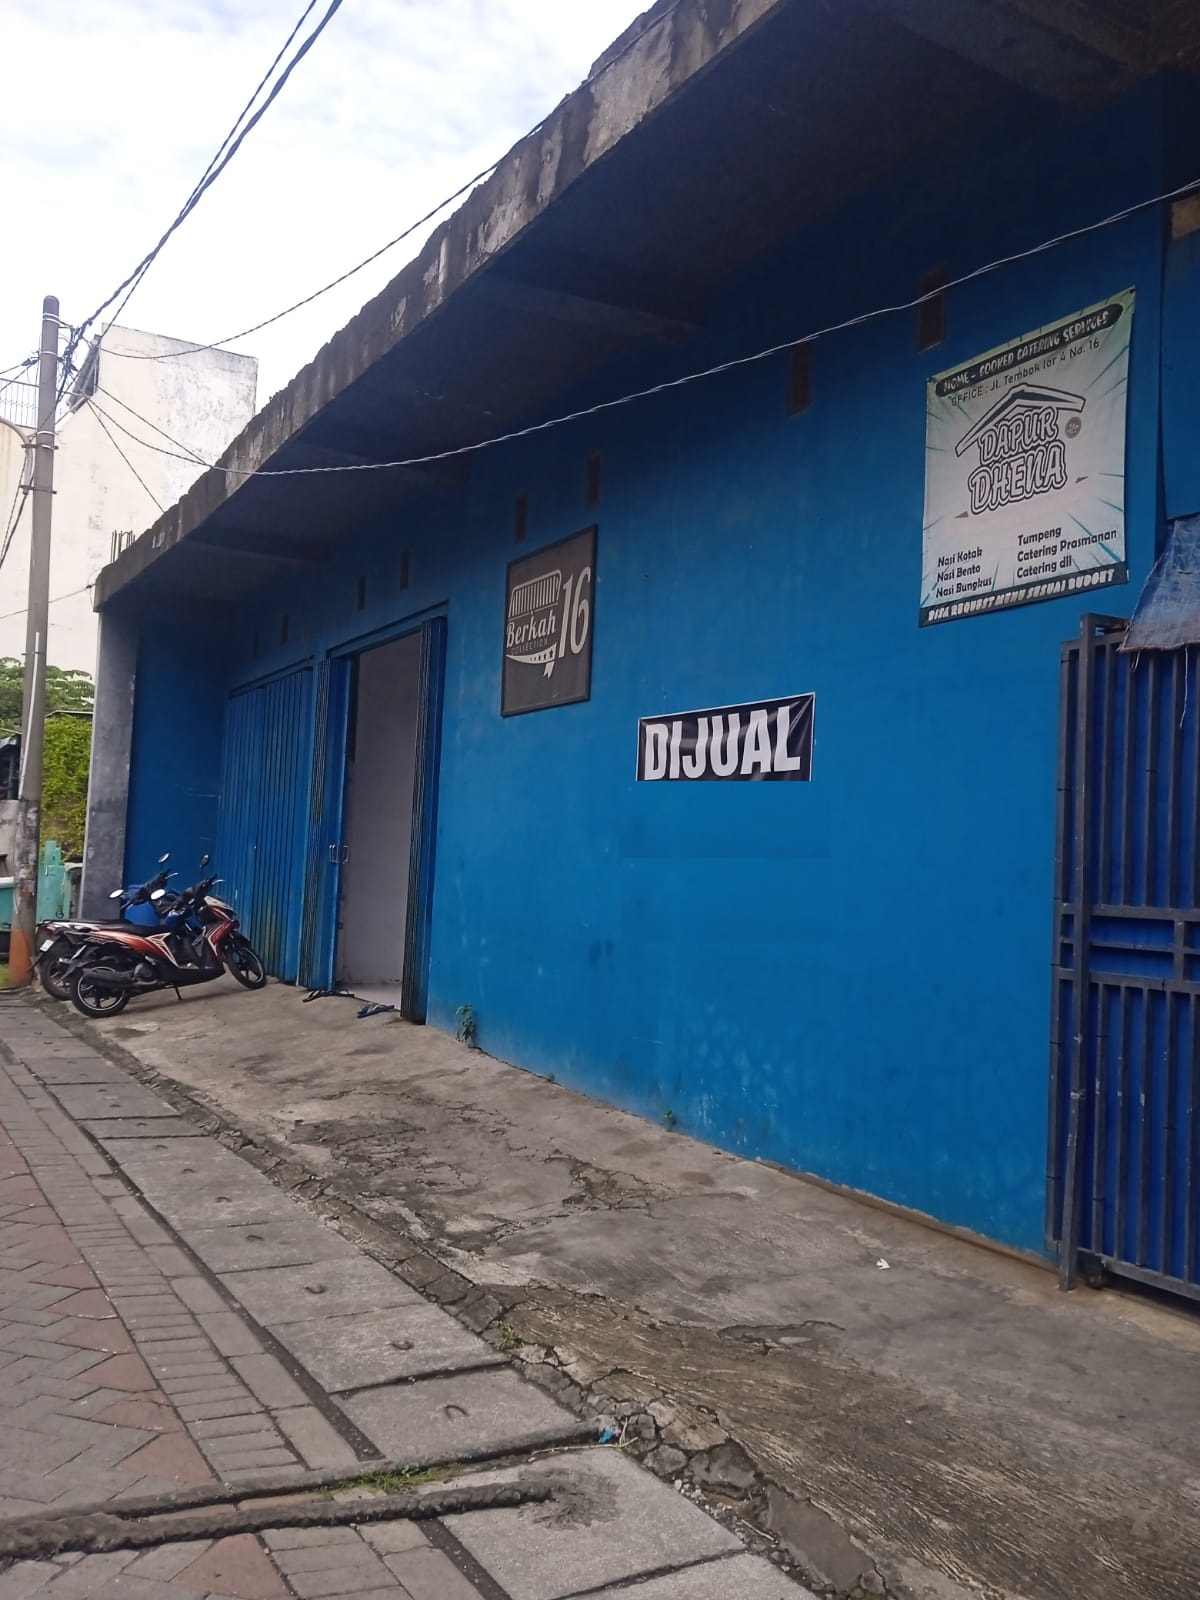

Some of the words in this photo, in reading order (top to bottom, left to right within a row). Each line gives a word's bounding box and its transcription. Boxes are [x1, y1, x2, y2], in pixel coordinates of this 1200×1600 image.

[944, 371, 970, 392] HOME
[979, 353, 1014, 376] COOKED
[1017, 334, 1060, 361] CATERING
[1062, 311, 1109, 341] SERVICES
[951, 385, 983, 406] OFFICE
[1004, 364, 1040, 385] Tembok
[1069, 347, 1085, 358] No.
[1089, 339, 1100, 351] 16
[979, 408, 1056, 463] DAPUR
[970, 442, 1065, 512] DHENA
[938, 554, 955, 567] Nasi
[957, 547, 982, 562] Kotak
[1018, 527, 1061, 546] Tumpeng
[1018, 545, 1057, 562] Catering
[1060, 529, 1117, 551] Prasmanan
[937, 569, 954, 583] Nasi
[957, 565, 980, 578] Bento
[1017, 561, 1057, 578] Catering
[1060, 555, 1072, 568] dll
[936, 585, 954, 598] Nasi
[956, 578, 992, 594] Bungkus
[951, 596, 995, 615] REQUEST
[1068, 569, 1114, 590] BUDGET
[506, 610, 556, 648] Berkah
[559, 566, 591, 658] 16
[644, 706, 801, 780] DIJUAL
